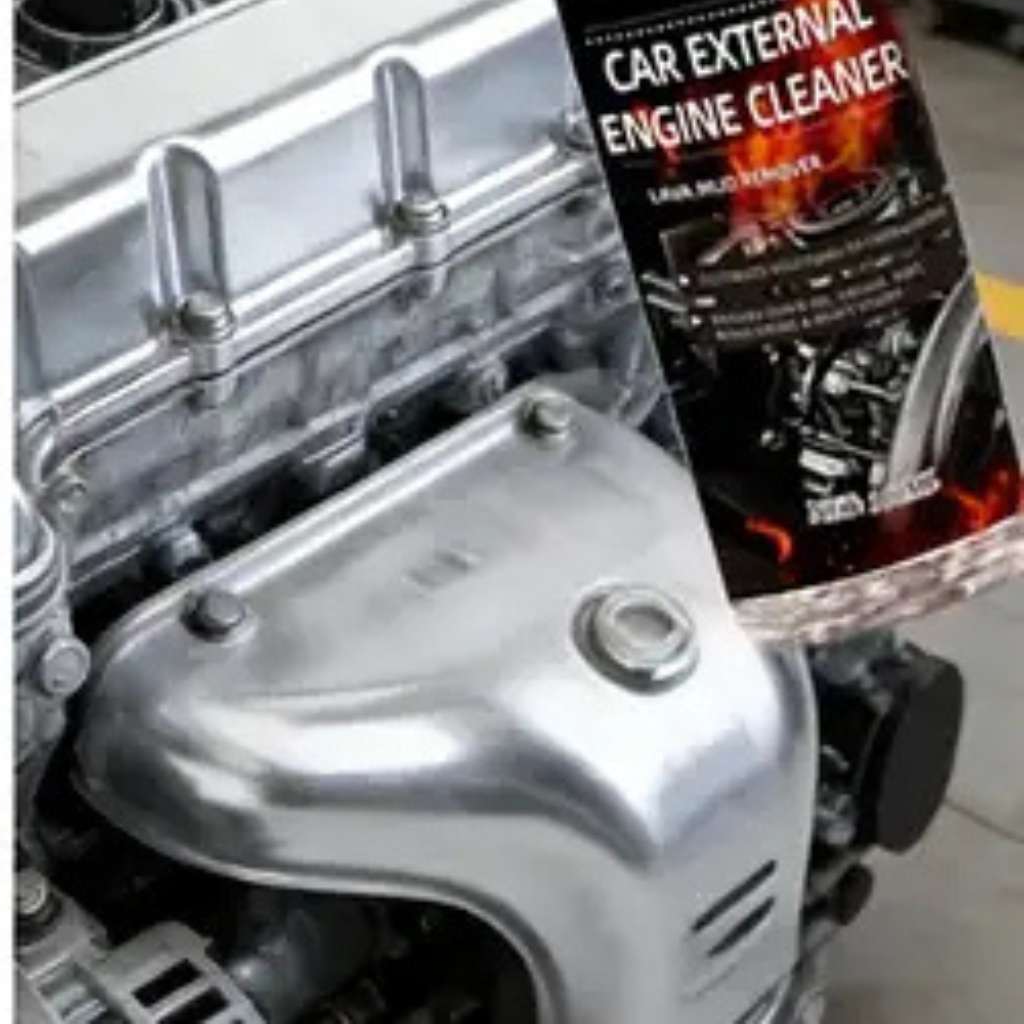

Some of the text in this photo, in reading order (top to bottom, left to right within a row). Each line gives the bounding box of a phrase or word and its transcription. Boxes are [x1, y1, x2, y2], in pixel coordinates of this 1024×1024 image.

[599, 41, 909, 157] ENGINE CLEANER
[603, 40, 682, 94] CAR
